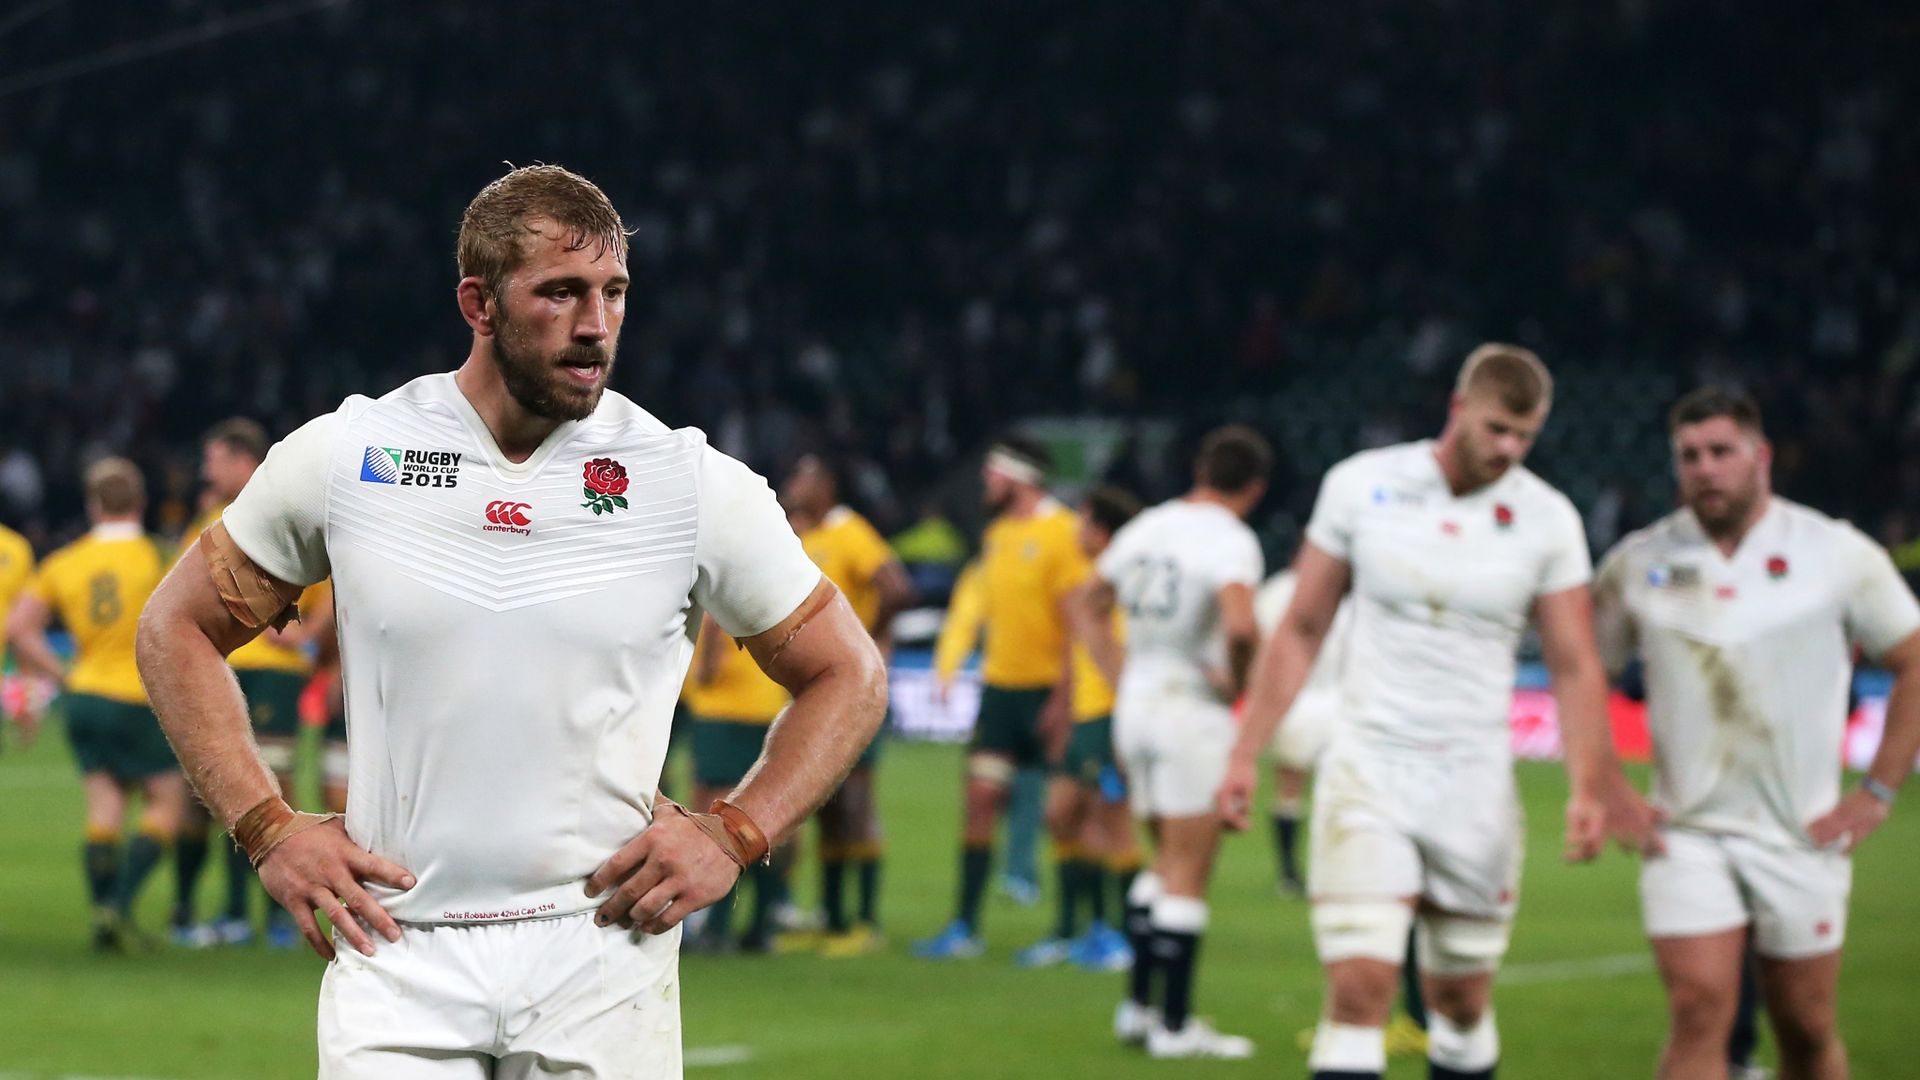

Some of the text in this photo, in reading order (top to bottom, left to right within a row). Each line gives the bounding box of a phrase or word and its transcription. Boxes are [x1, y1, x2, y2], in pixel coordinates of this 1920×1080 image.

[404, 449, 462, 467] RUGBY
[403, 464, 460, 474] WORLD CUP
[400, 472, 457, 488] 2015
[482, 524, 531, 536] canterbury
[1126, 554, 1182, 620] 23
[89, 569, 122, 627] 8
[443, 911, 463, 919] Chris
[464, 911, 499, 919] Robshaw
[500, 909, 520, 918] 42nd
[521, 907, 536, 917] Cap
